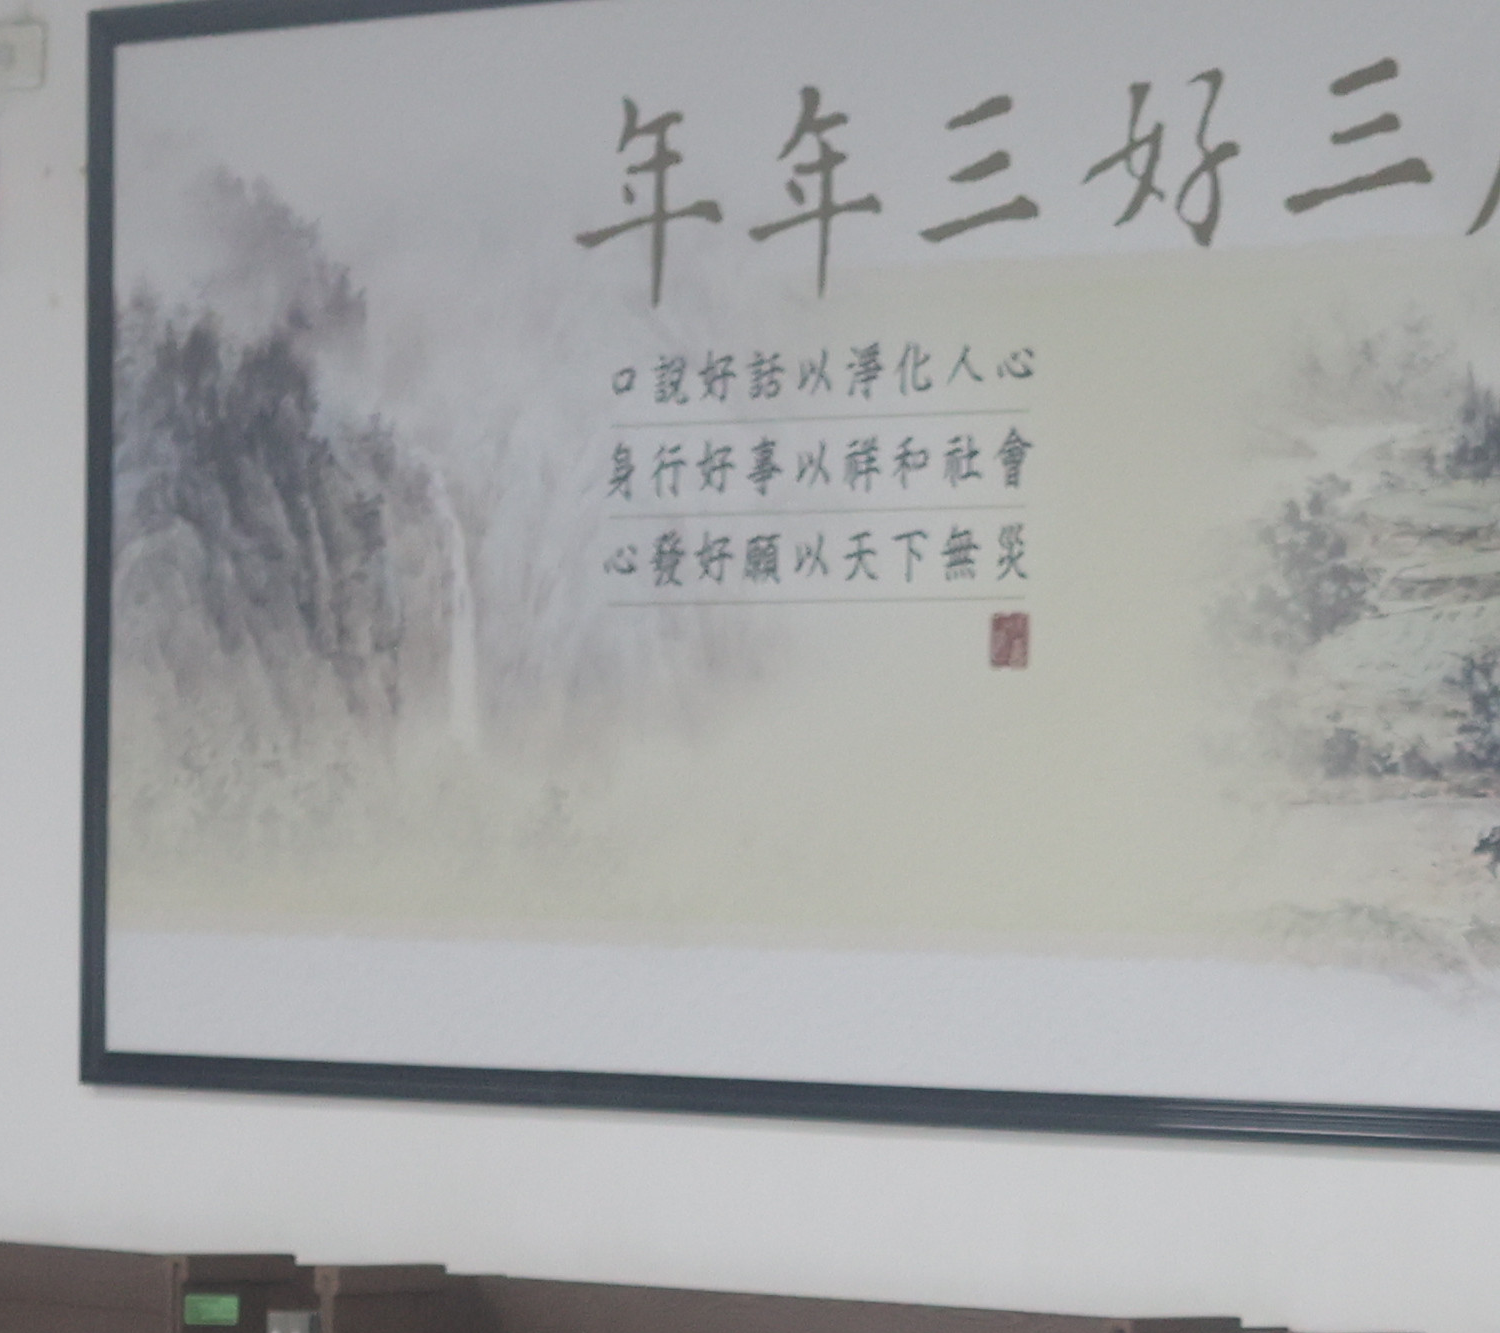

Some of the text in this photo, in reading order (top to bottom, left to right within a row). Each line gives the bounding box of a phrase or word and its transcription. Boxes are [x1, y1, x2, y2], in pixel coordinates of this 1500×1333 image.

[611, 340, 1035, 405] 口說好話以淨化人心
[606, 427, 1033, 500] 身行好事以祥和社會
[603, 523, 1030, 587] 心發好願以天下無災
